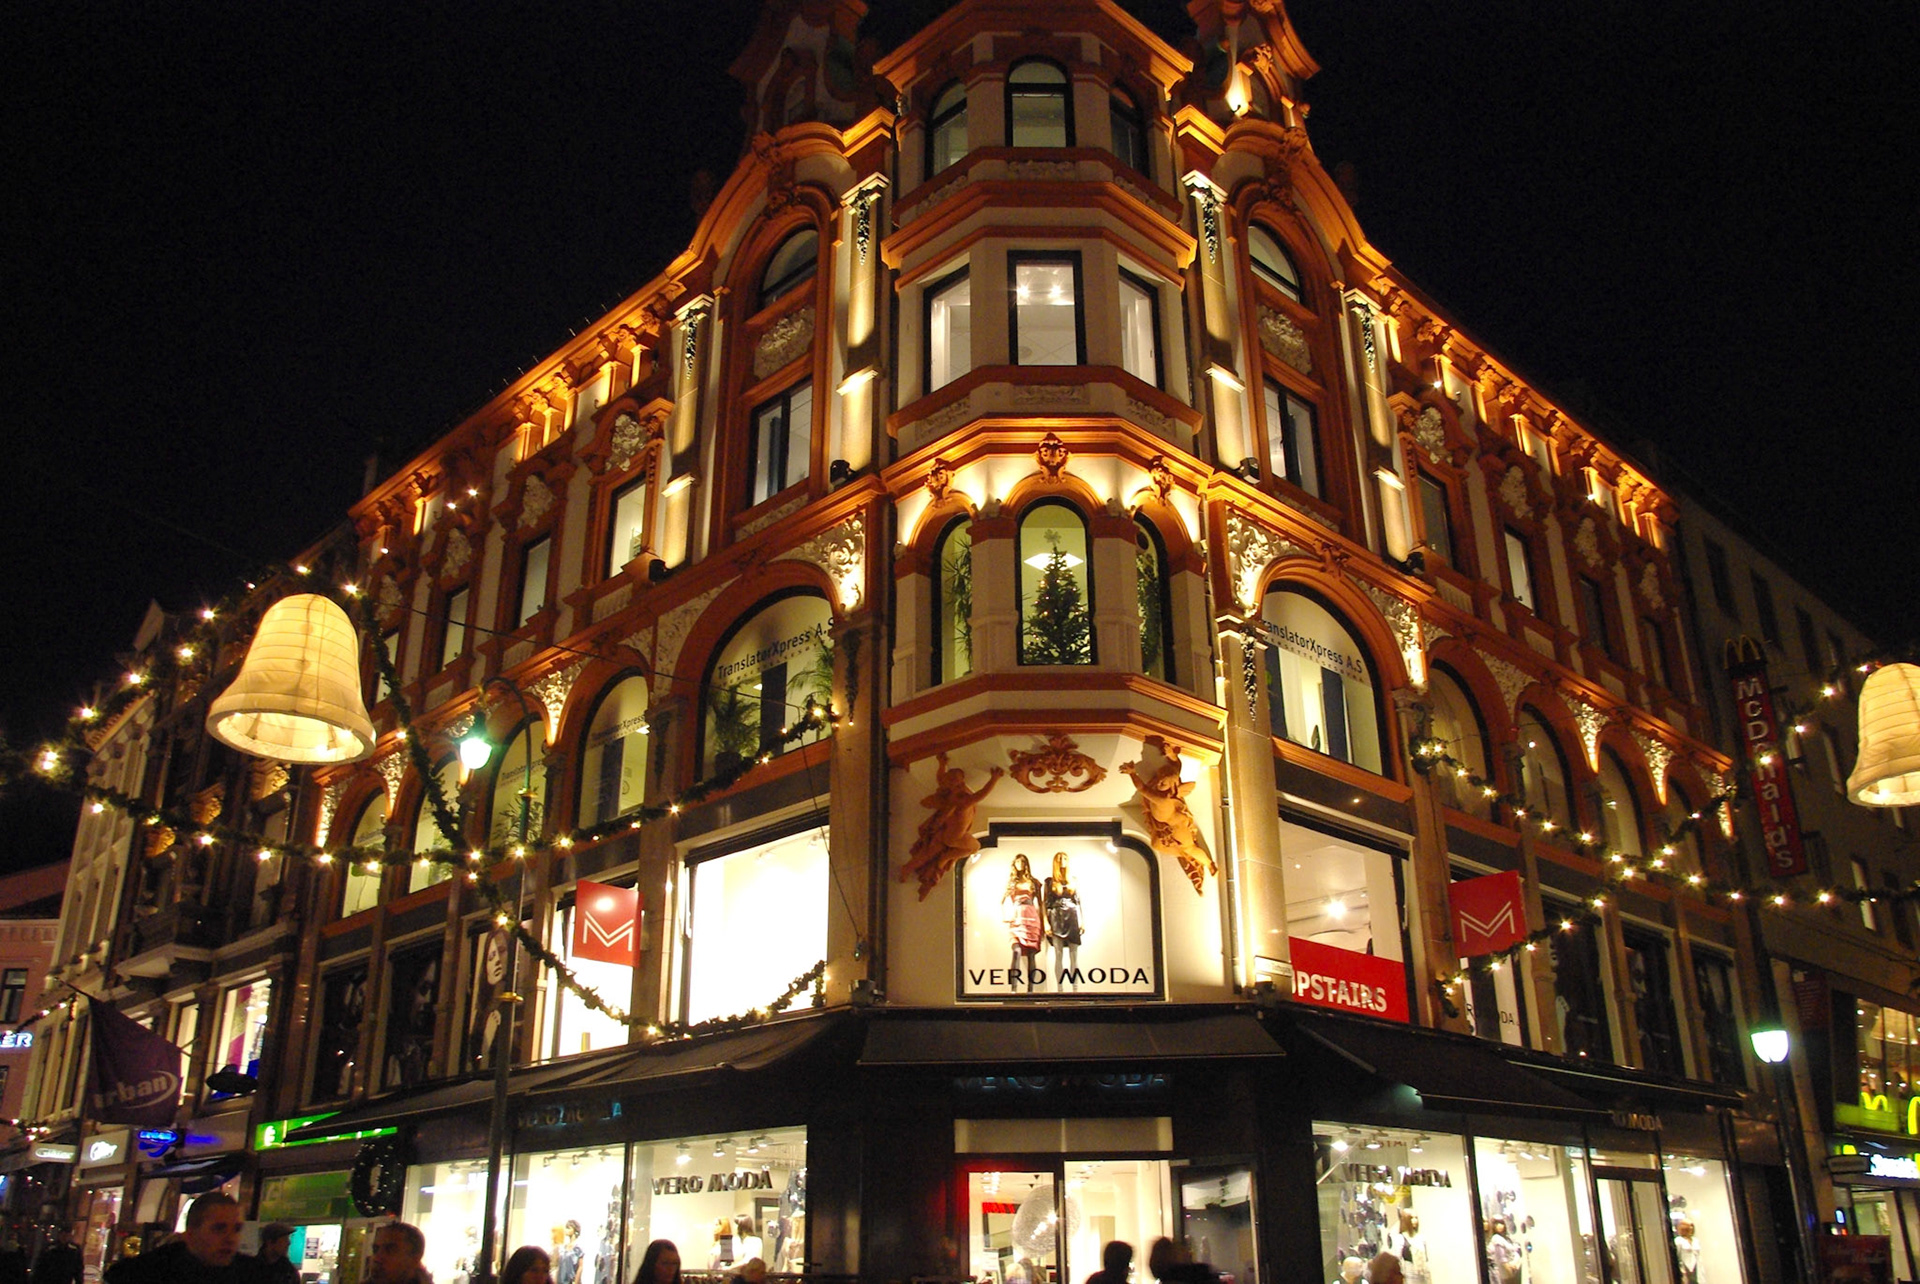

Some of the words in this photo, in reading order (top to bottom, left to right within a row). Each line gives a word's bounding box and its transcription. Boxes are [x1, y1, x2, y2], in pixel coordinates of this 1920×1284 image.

[968, 968, 1047, 986] VERO
[1058, 967, 1149, 985] MODA
[651, 1174, 704, 1196] VERO
[707, 1169, 773, 1193] MODA
